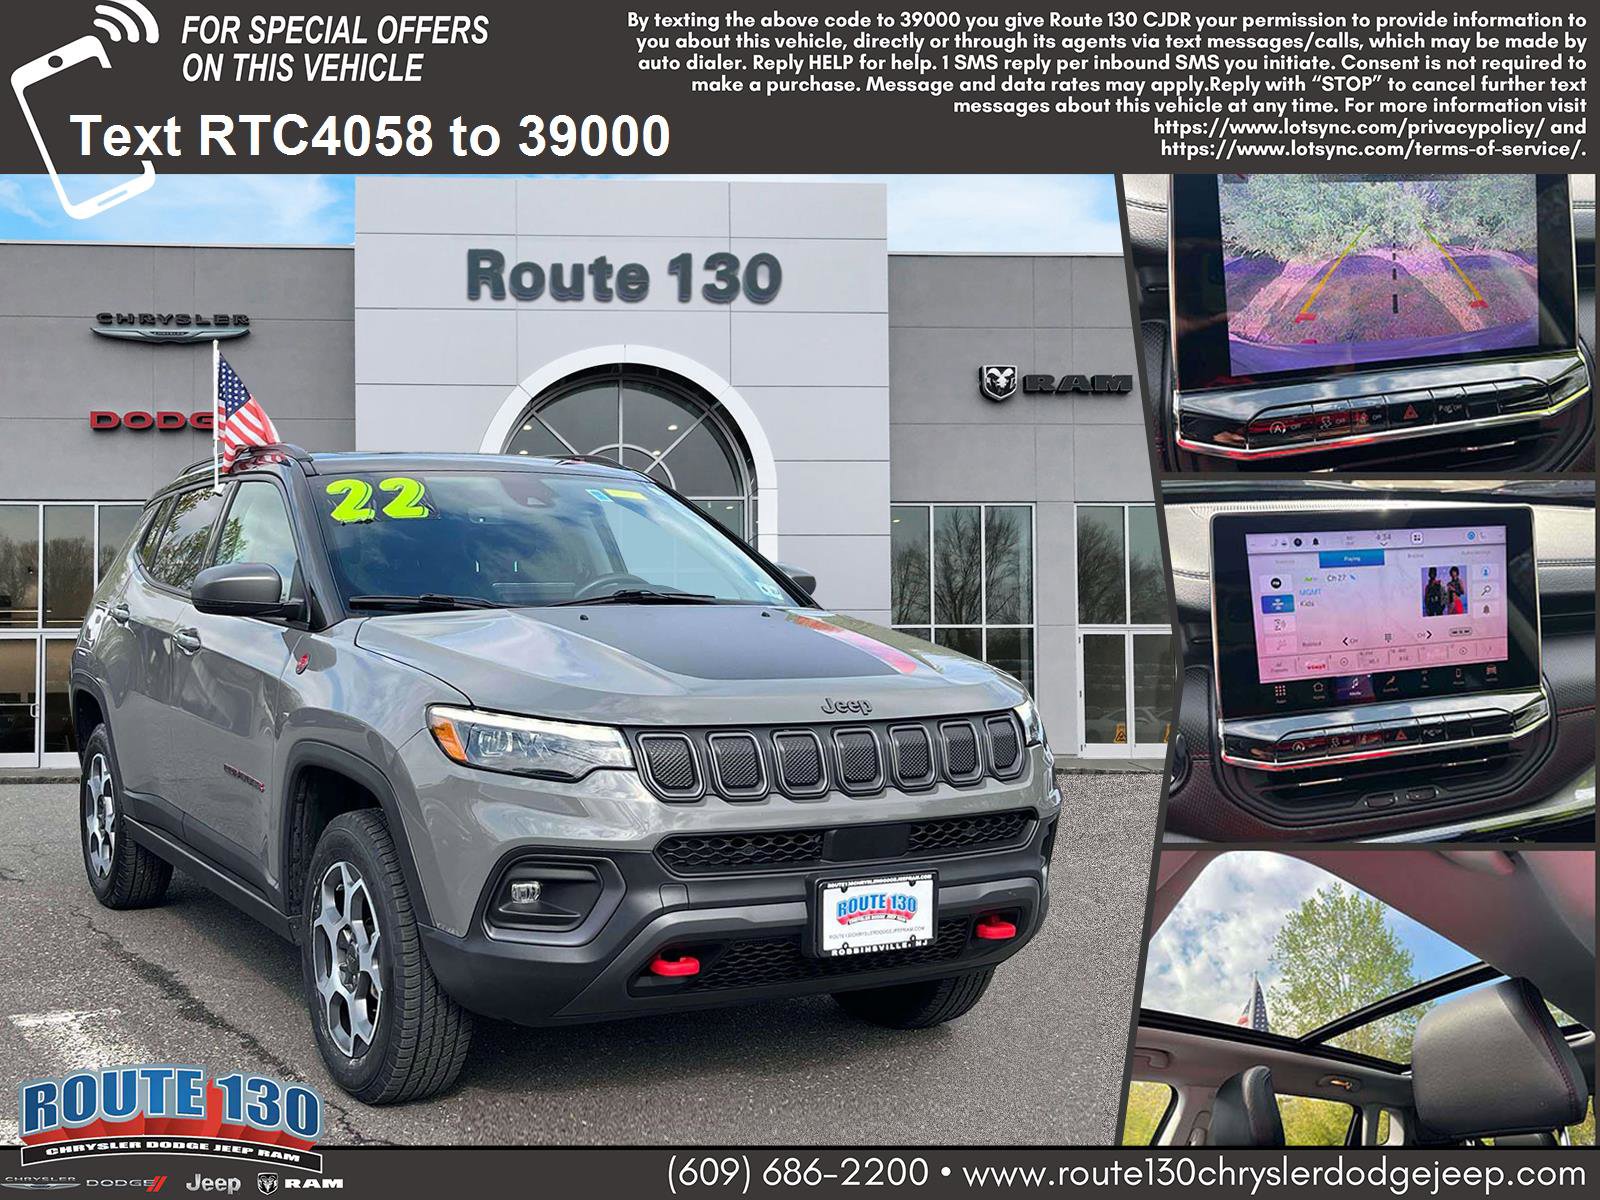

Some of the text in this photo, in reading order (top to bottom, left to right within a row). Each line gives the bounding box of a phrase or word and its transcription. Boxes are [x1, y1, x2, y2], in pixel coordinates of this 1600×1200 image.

[467, 248, 782, 304] Route 130
[96, 312, 250, 326] CHRYSLER
[1022, 373, 1134, 395] RAM
[89, 410, 214, 430] DODG
[326, 477, 429, 522] 22
[821, 698, 873, 716] Jeep
[837, 893, 918, 917] ROUTE 130
[915, 939, 928, 947] NJ
